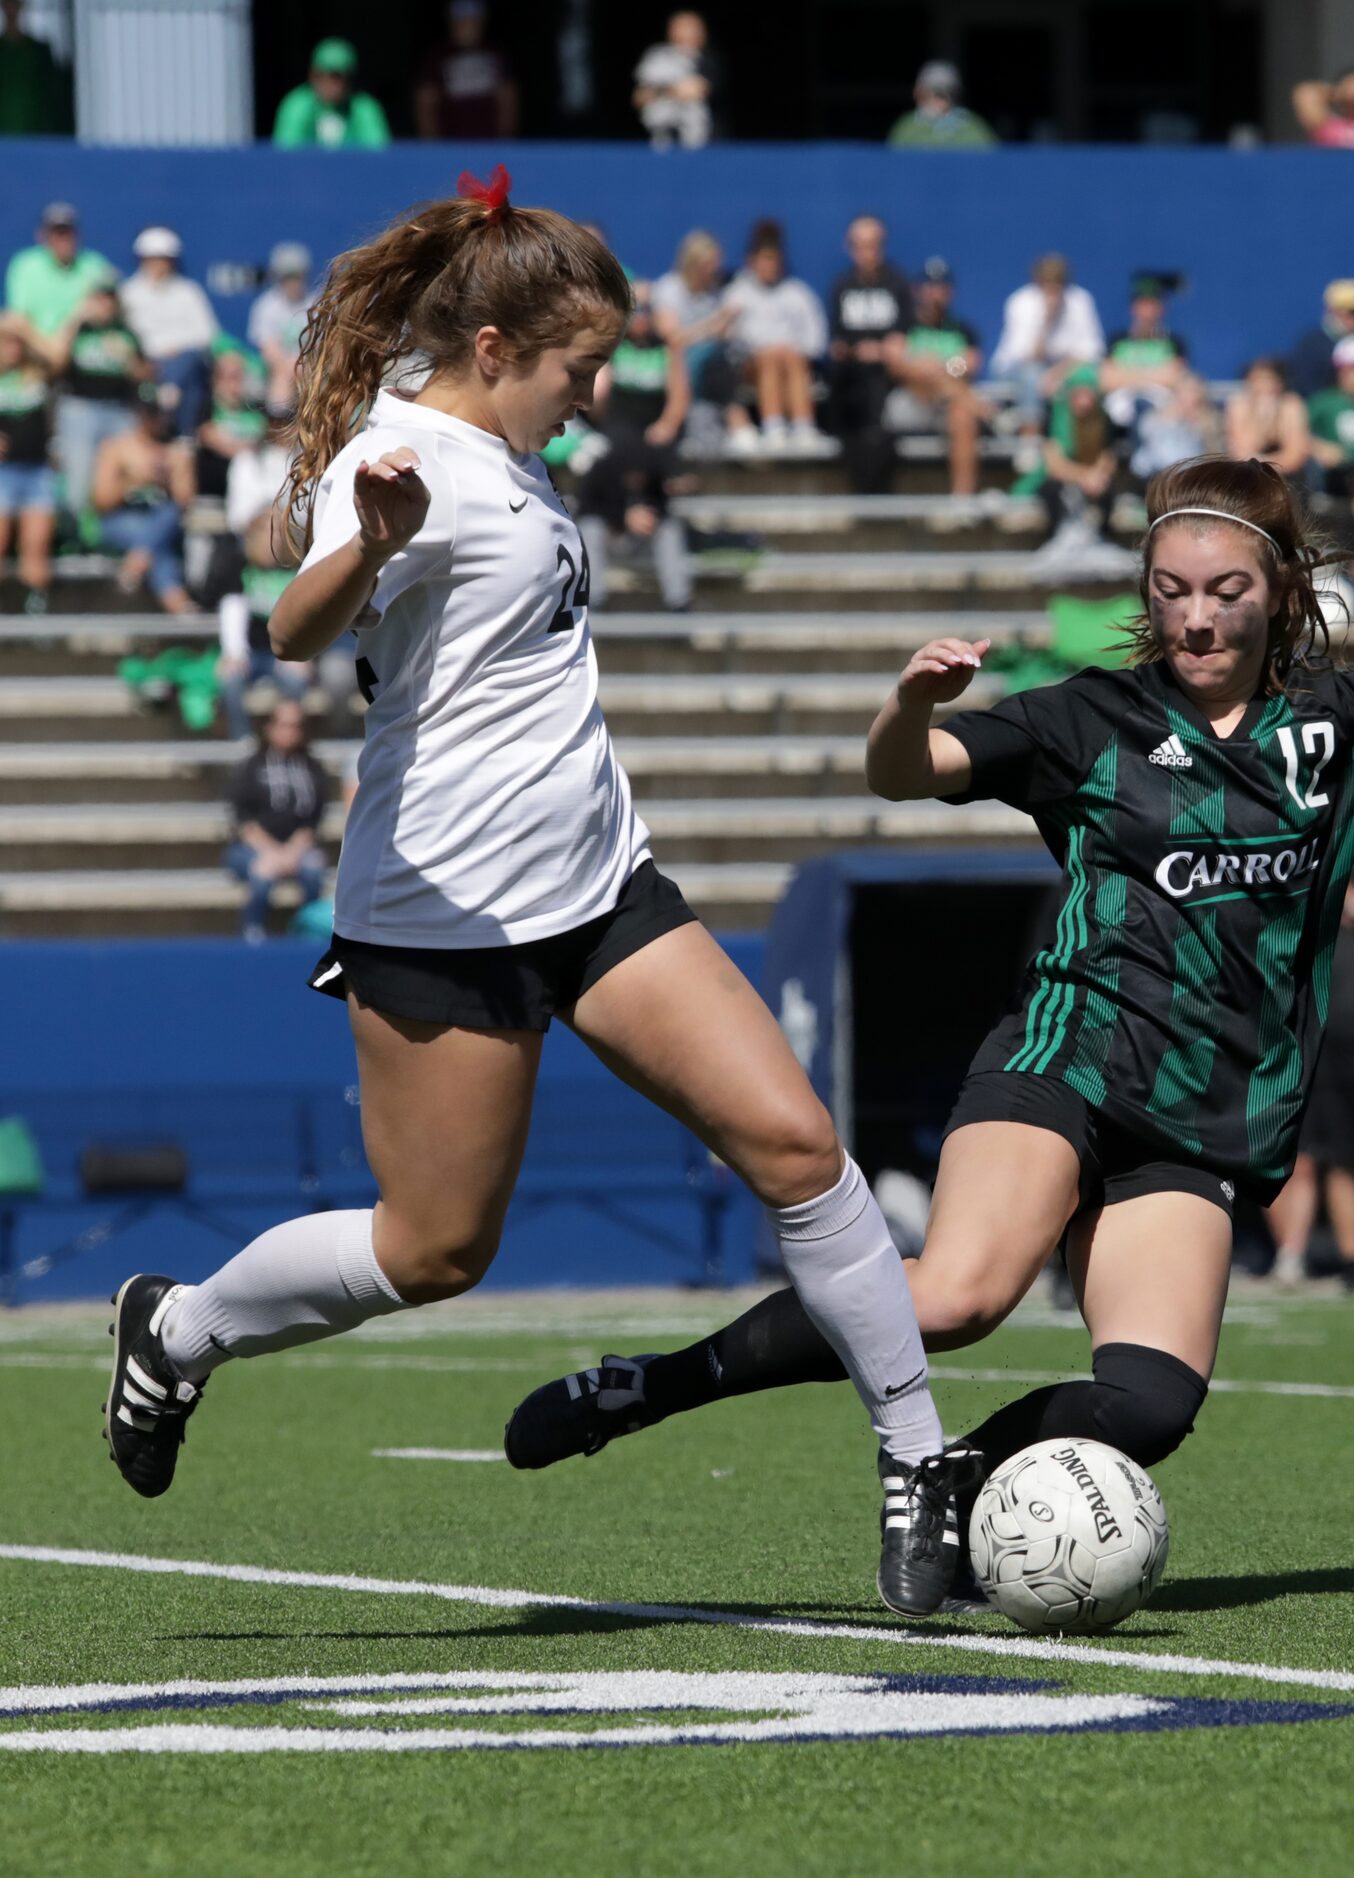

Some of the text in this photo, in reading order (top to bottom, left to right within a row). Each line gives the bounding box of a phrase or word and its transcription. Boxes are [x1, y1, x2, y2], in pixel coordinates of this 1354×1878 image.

[547, 536, 590, 633] 24
[1148, 753, 1193, 767] adidas
[1276, 721, 1335, 810] 12
[1154, 837, 1319, 899] CARROLL
[1050, 1447, 1123, 1544] SPALDING
